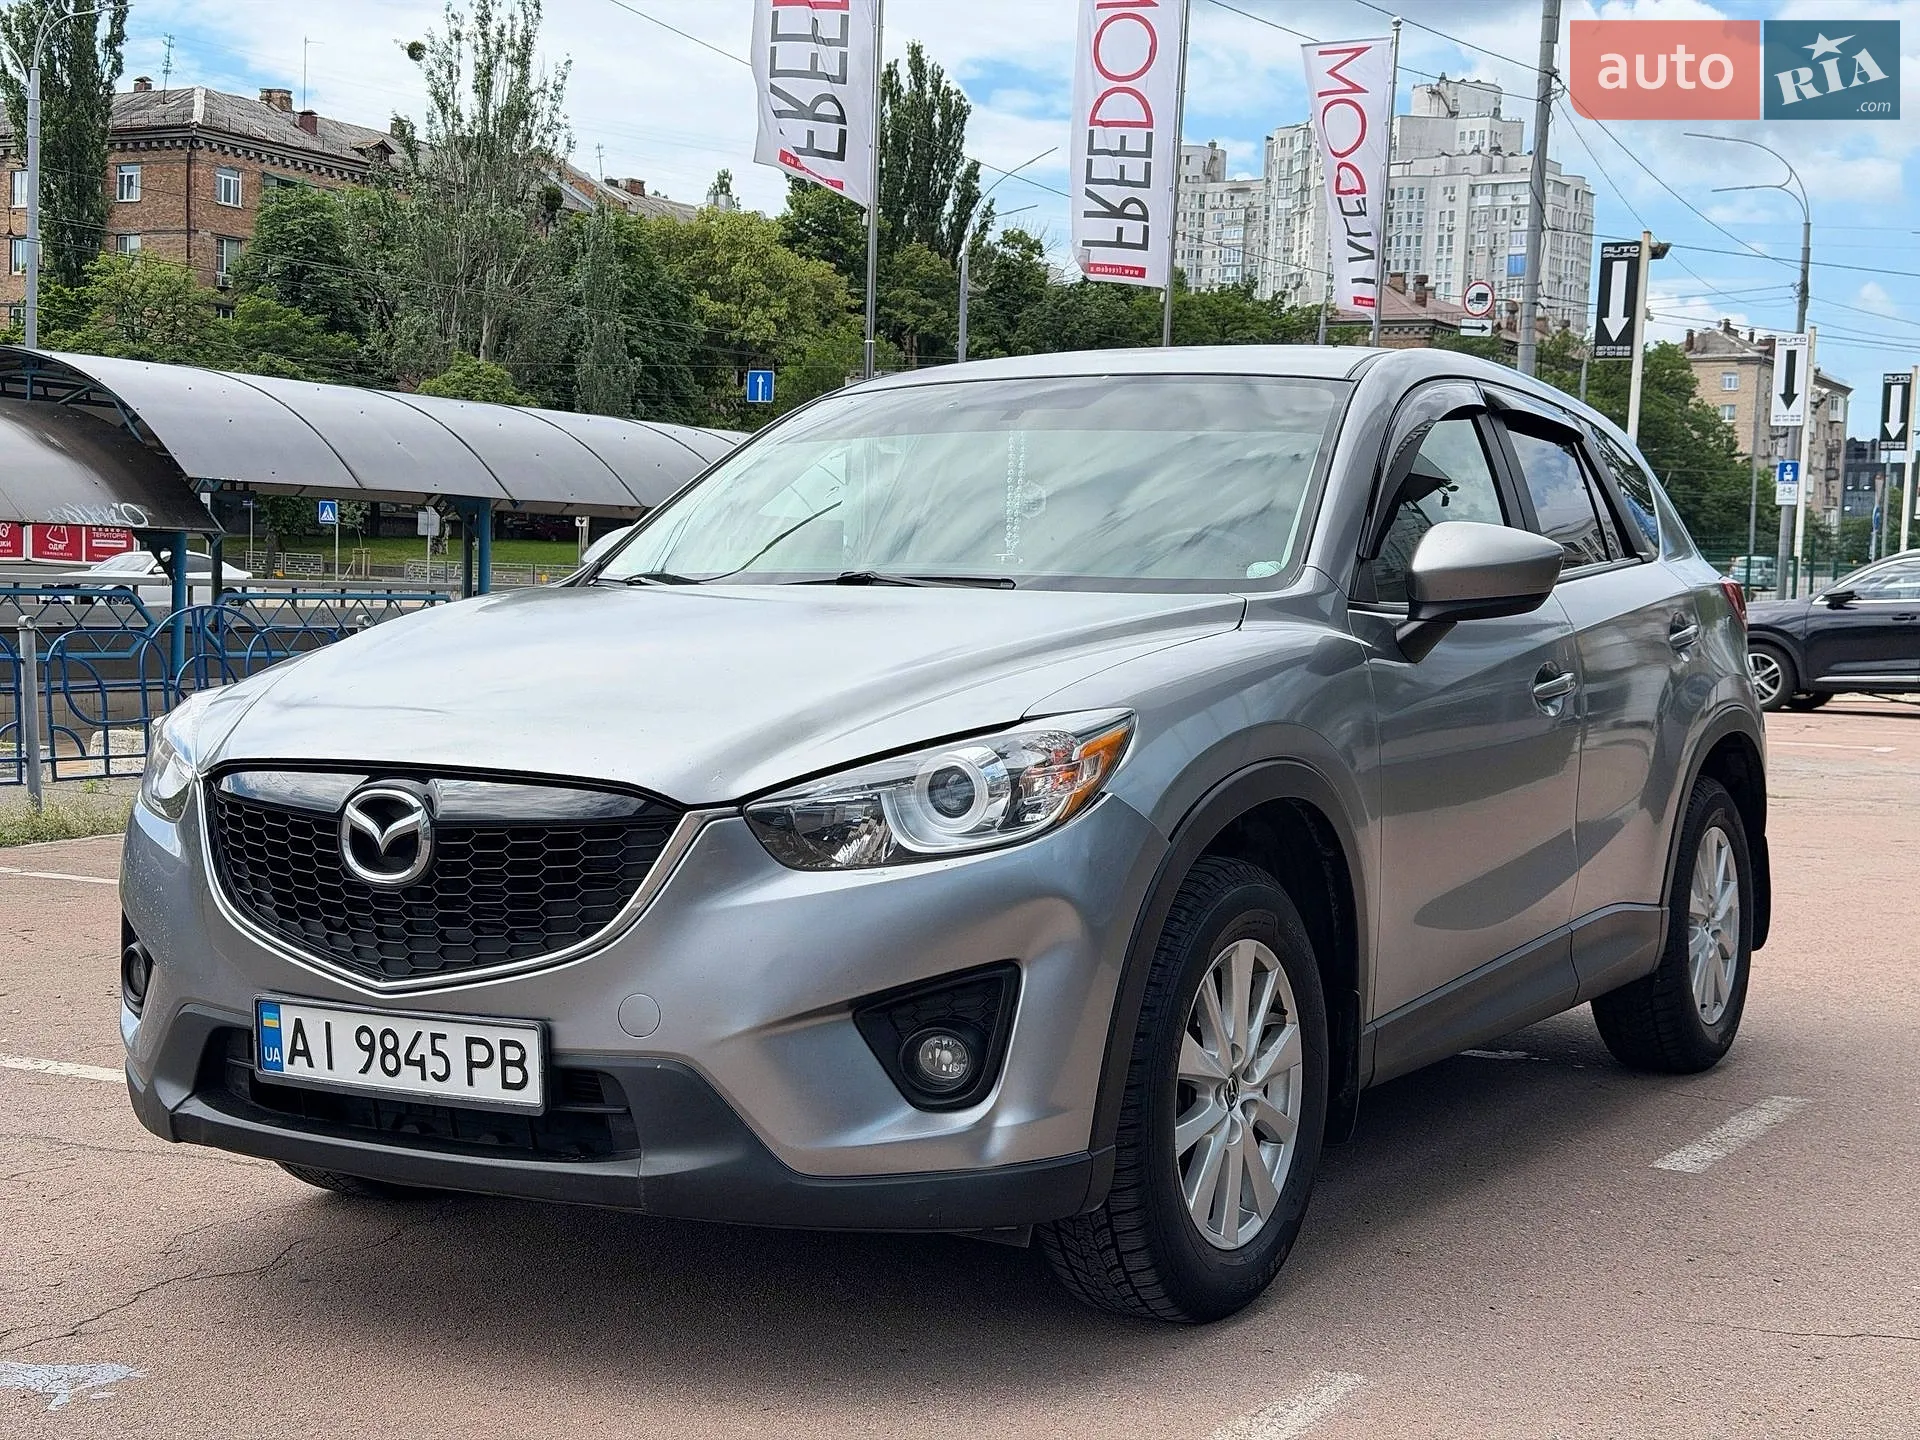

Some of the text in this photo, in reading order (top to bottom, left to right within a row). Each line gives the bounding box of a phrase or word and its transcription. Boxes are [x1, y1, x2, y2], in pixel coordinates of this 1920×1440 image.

[1602, 245, 1640, 253] AUTO
[264, 1046, 281, 1063] UA
[354, 1025, 451, 1082] 9845
